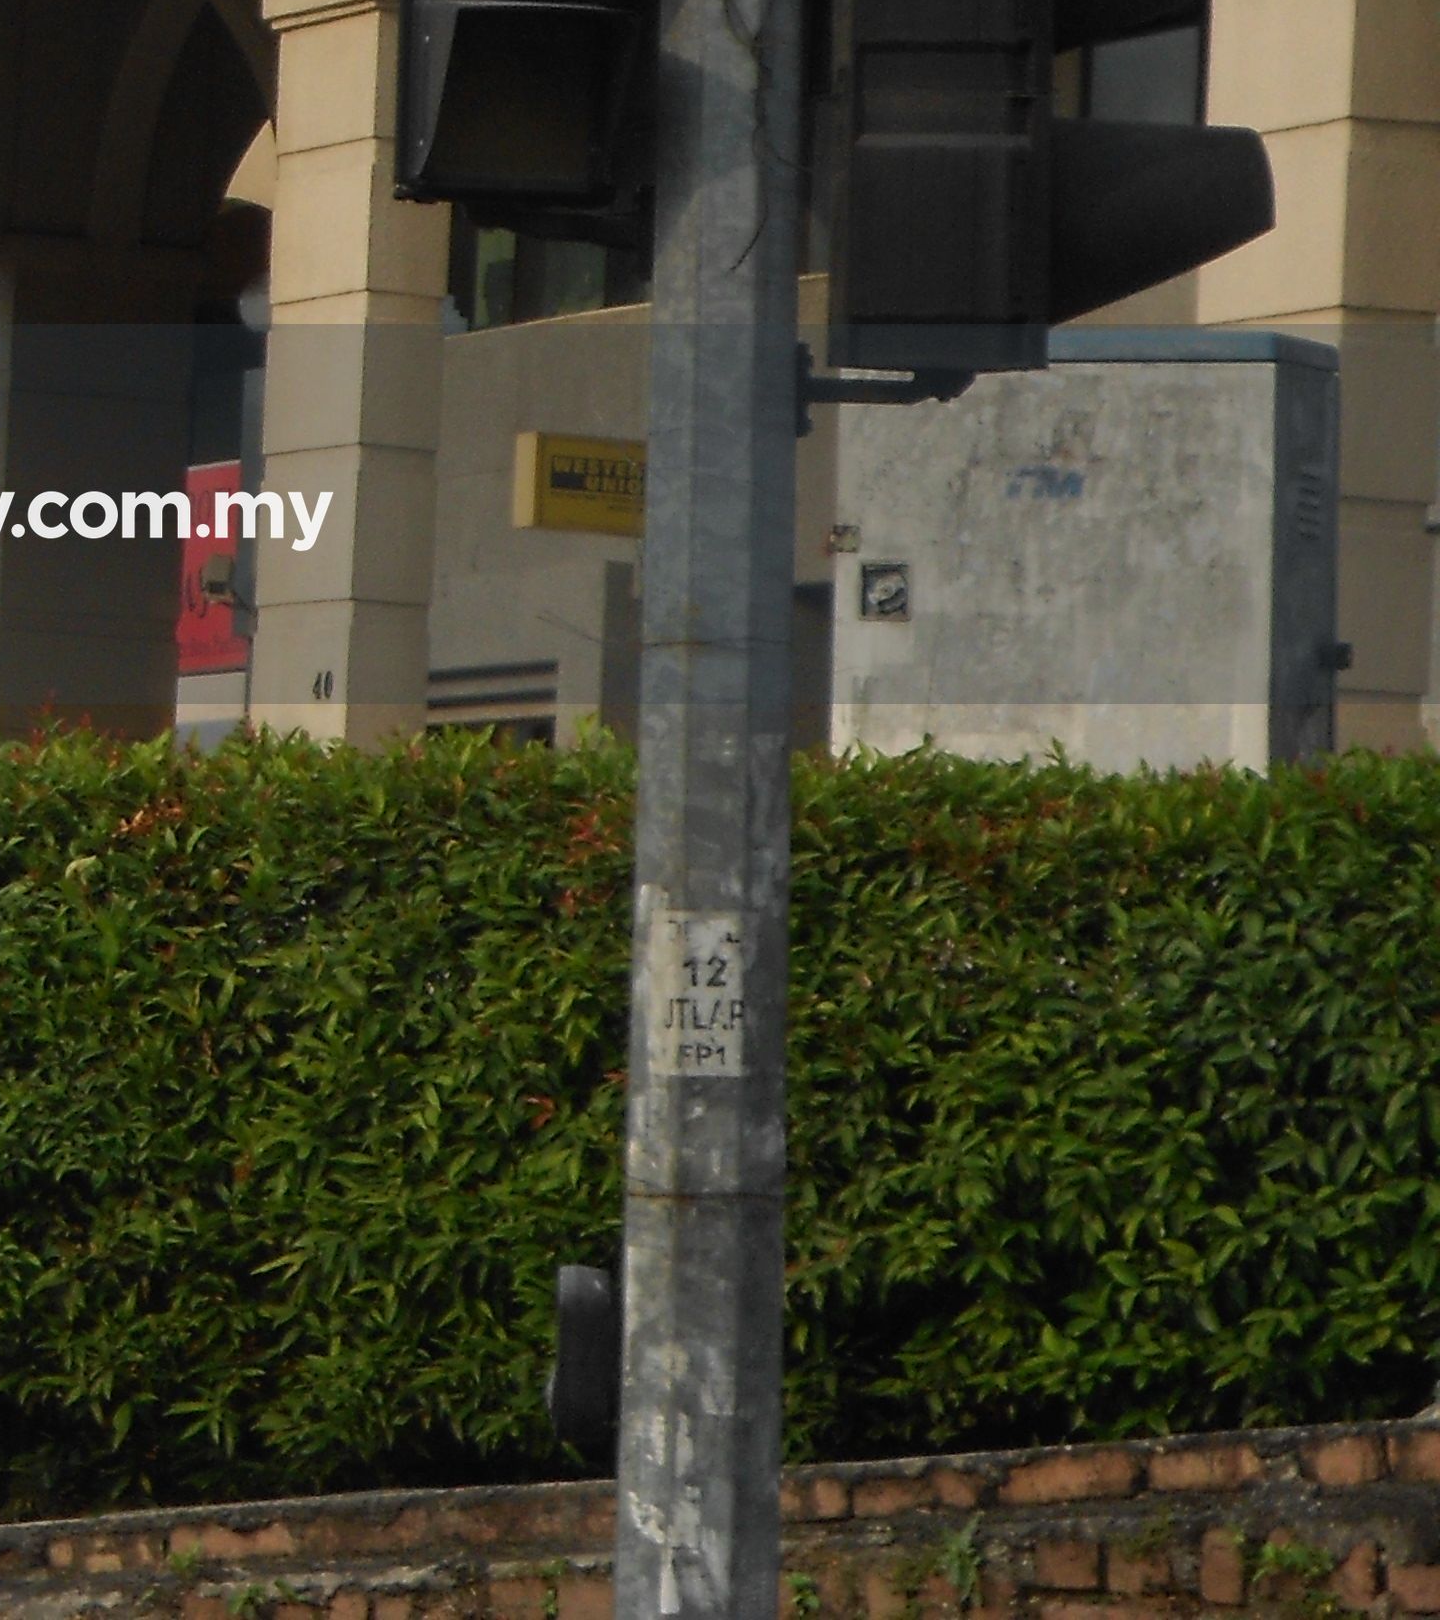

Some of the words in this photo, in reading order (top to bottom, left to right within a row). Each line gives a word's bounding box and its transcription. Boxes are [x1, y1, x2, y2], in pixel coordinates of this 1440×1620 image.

[552, 456, 645, 478] WESTER
[584, 474, 644, 496] UNIO
[682, 956, 727, 988] 12
